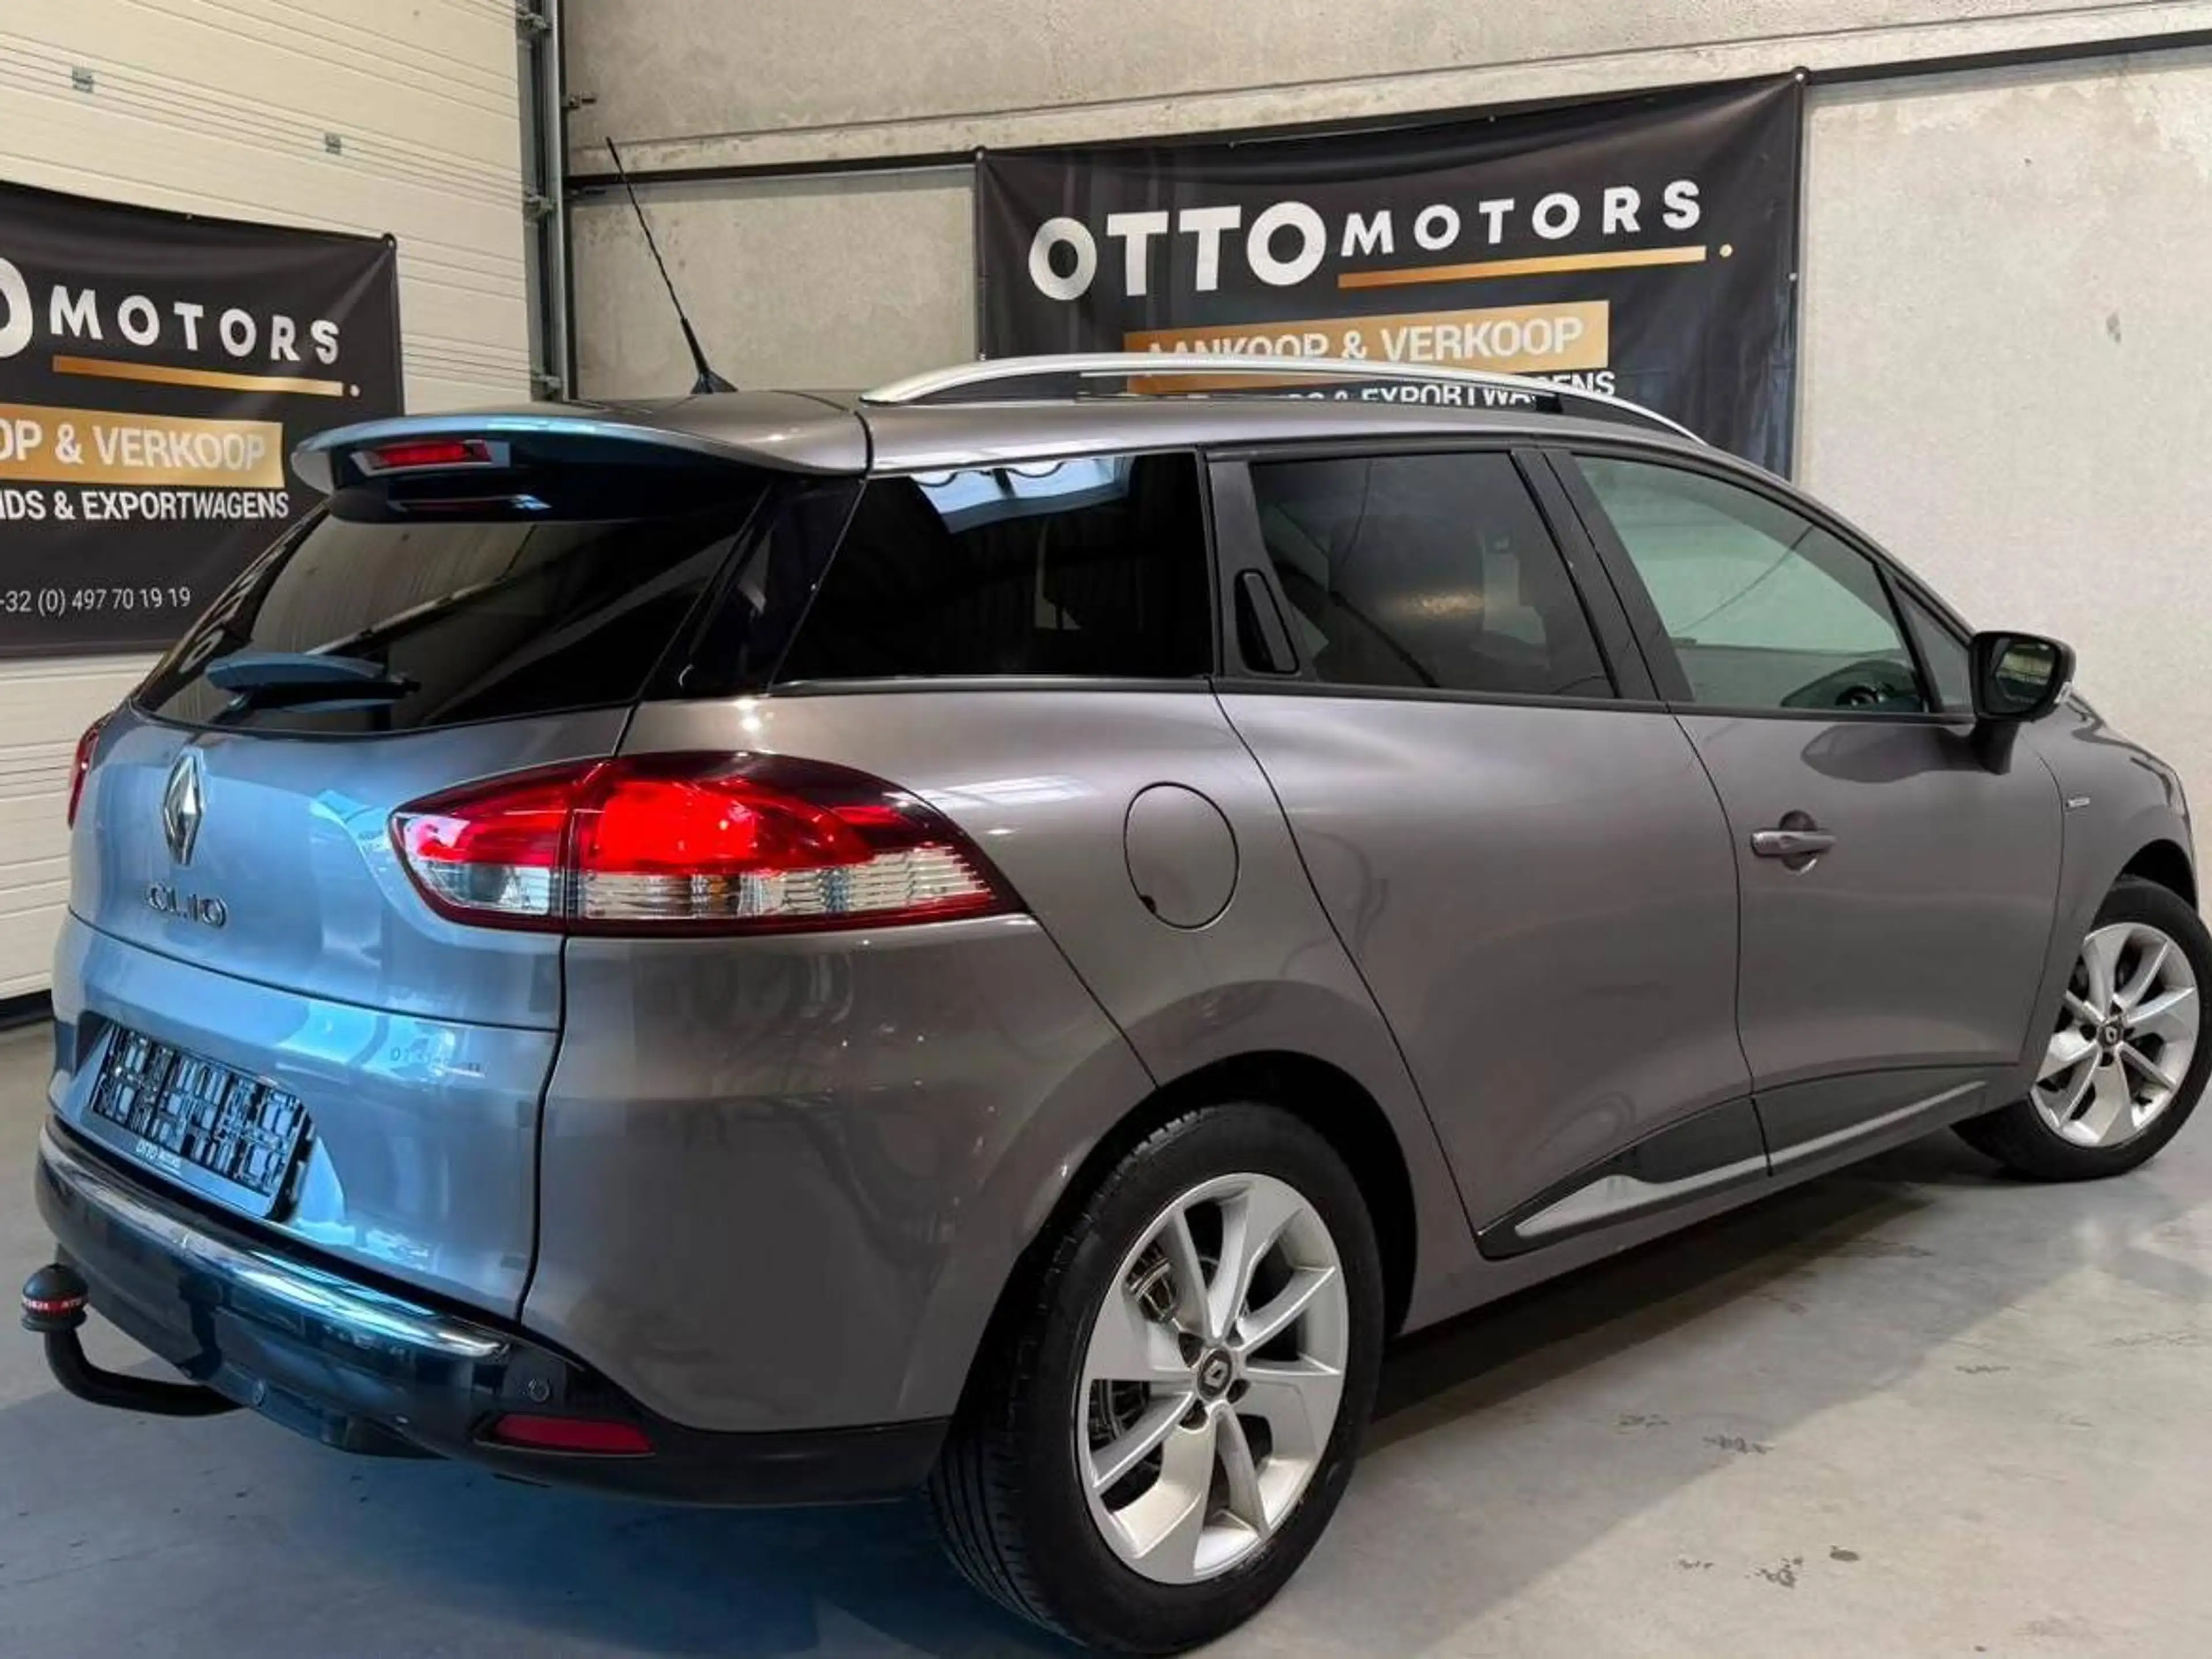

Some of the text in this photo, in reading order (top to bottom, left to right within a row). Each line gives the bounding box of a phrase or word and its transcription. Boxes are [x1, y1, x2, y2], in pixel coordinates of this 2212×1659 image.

[1028, 180, 1700, 301] OTTO MOTORS
[50, 286, 341, 365] MOTORS
[1341, 329, 1368, 359] &
[1381, 316, 1585, 363] VERKOOP
[55, 423, 85, 464] &
[92, 425, 266, 471] VERKOOP
[54, 490, 76, 519] &
[81, 491, 289, 520] EXPORTWAGENS
[38, 588, 66, 617] (0)
[71, 588, 107, 611] 497
[112, 588, 134, 610] 70
[139, 586, 162, 609] 19
[167, 586, 191, 608] 19
